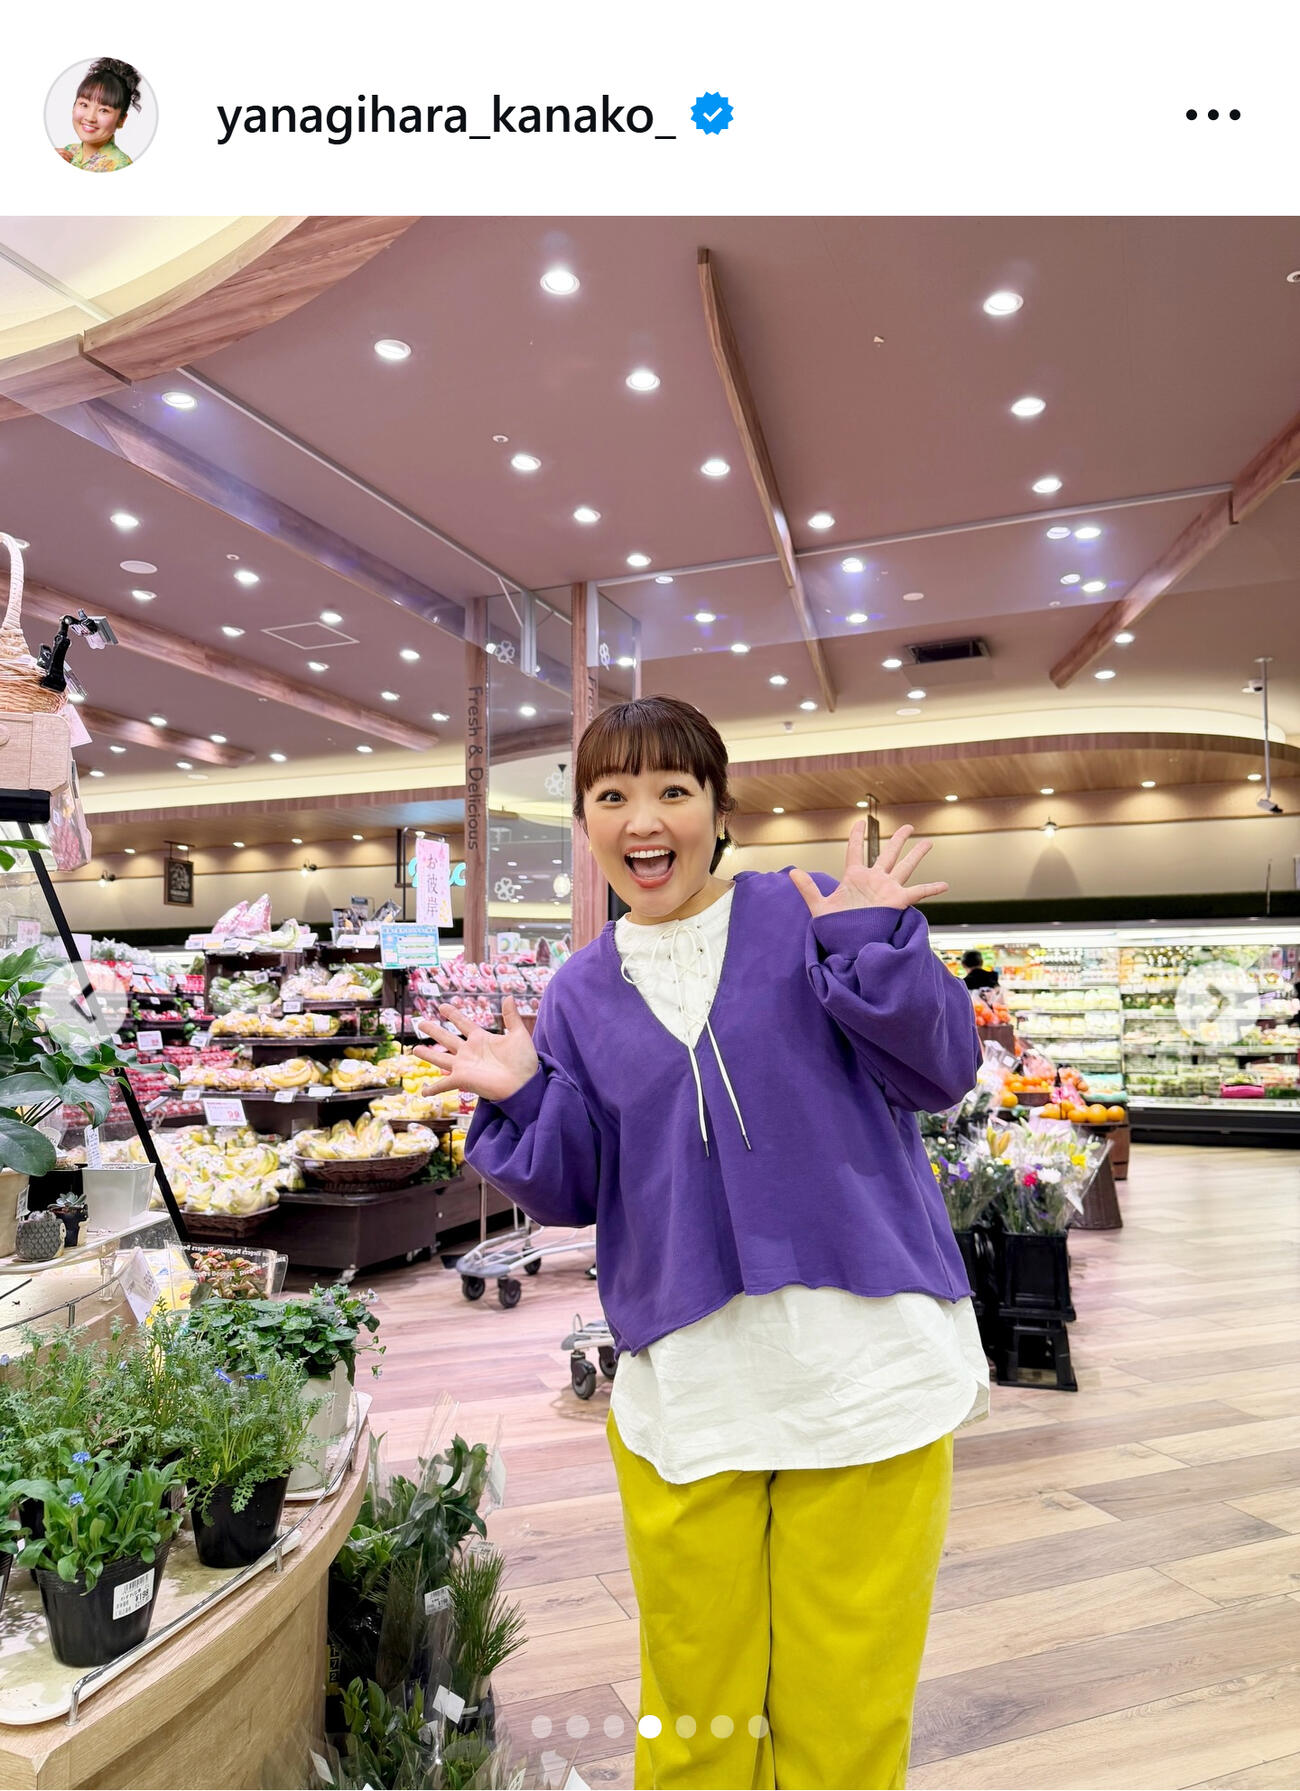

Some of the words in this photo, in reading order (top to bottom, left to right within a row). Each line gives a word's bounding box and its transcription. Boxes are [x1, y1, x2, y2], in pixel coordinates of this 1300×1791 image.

[467, 686, 484, 738] Fresh
[468, 744, 484, 760] &
[467, 767, 484, 850] Delicious
[426, 853, 439, 918] お彼岸
